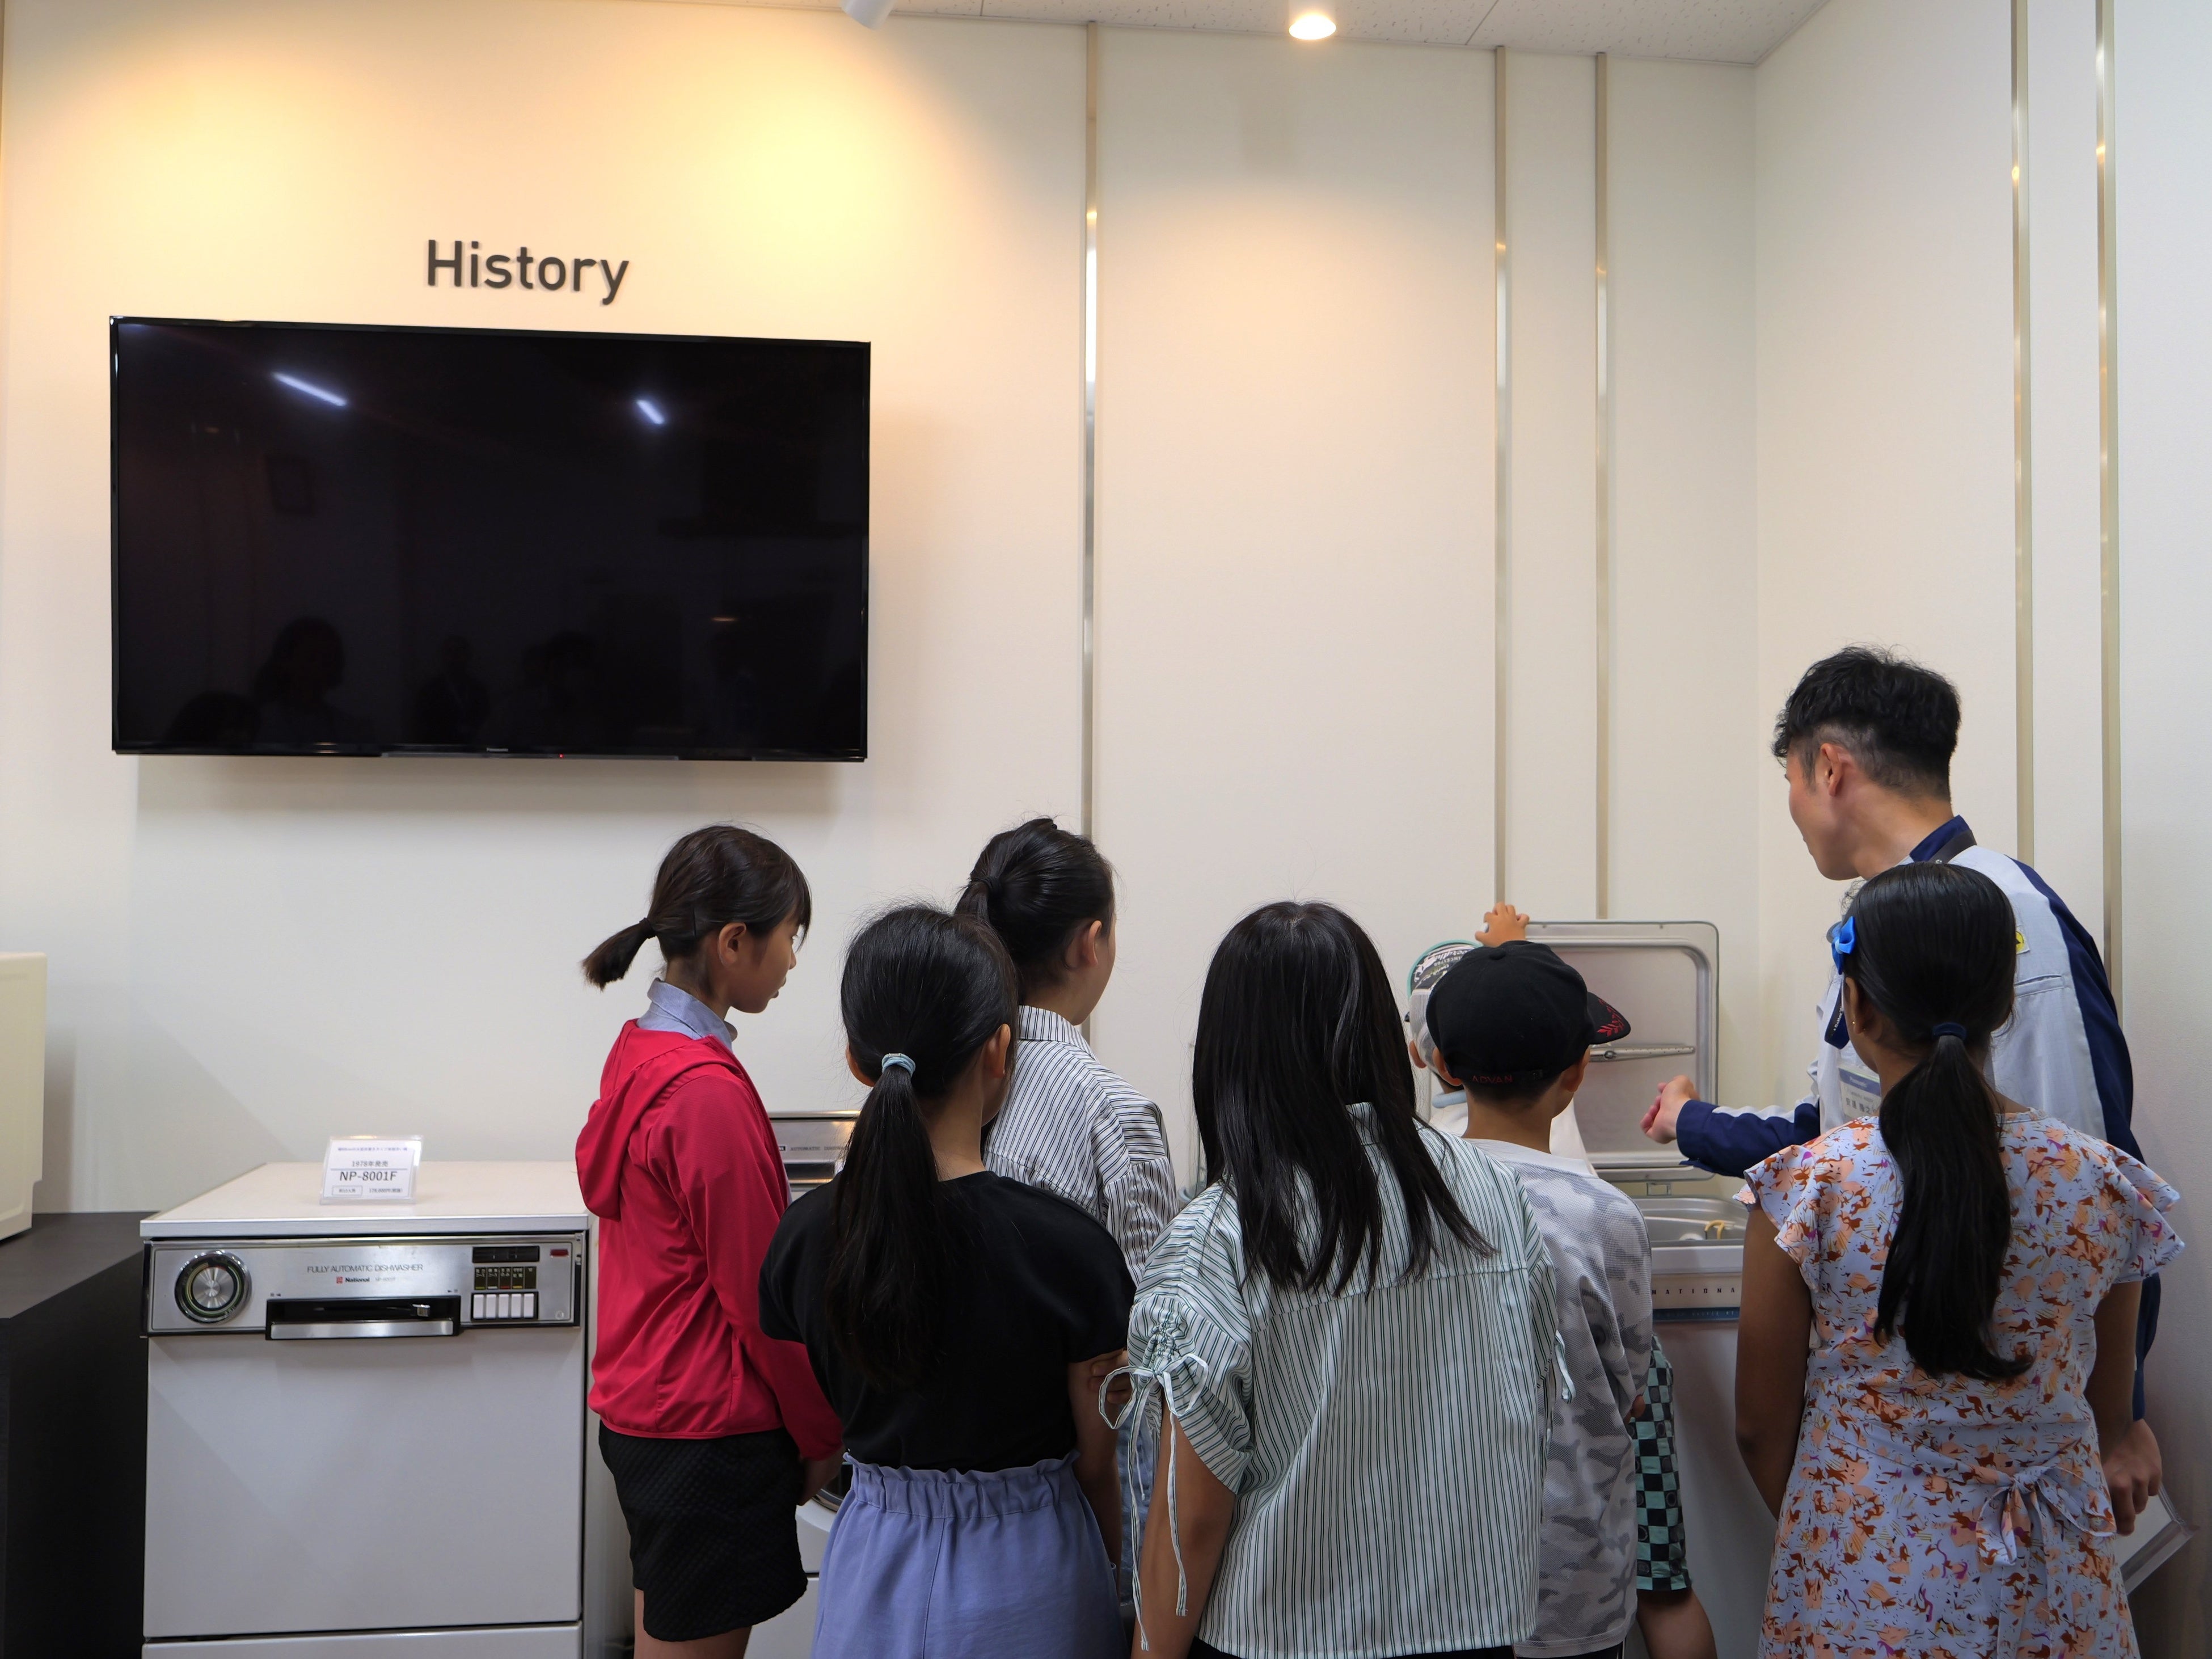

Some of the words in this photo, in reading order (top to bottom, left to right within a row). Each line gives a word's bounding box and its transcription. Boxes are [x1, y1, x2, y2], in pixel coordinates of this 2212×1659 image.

[428, 239, 630, 306] History
[1472, 1075, 1514, 1084] ADVAN
[340, 1171, 398, 1181] NP-8001F
